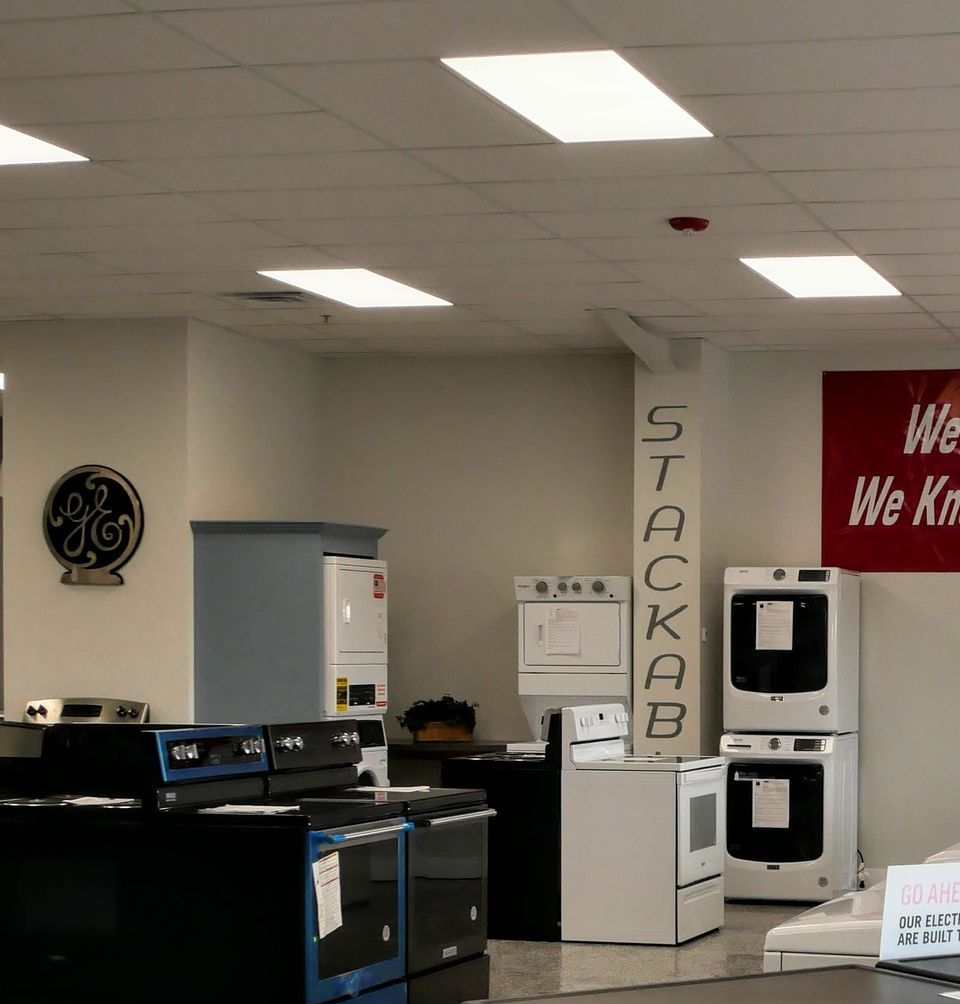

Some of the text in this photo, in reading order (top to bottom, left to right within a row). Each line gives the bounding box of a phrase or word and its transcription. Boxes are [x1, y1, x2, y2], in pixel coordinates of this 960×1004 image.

[848, 475, 905, 526] We
[640, 404, 689, 757] STACKAB
[900, 883, 923, 906] GO
[899, 915, 921, 929] OUR
[897, 930, 919, 946] ARE
[922, 928, 952, 945] BUILT
